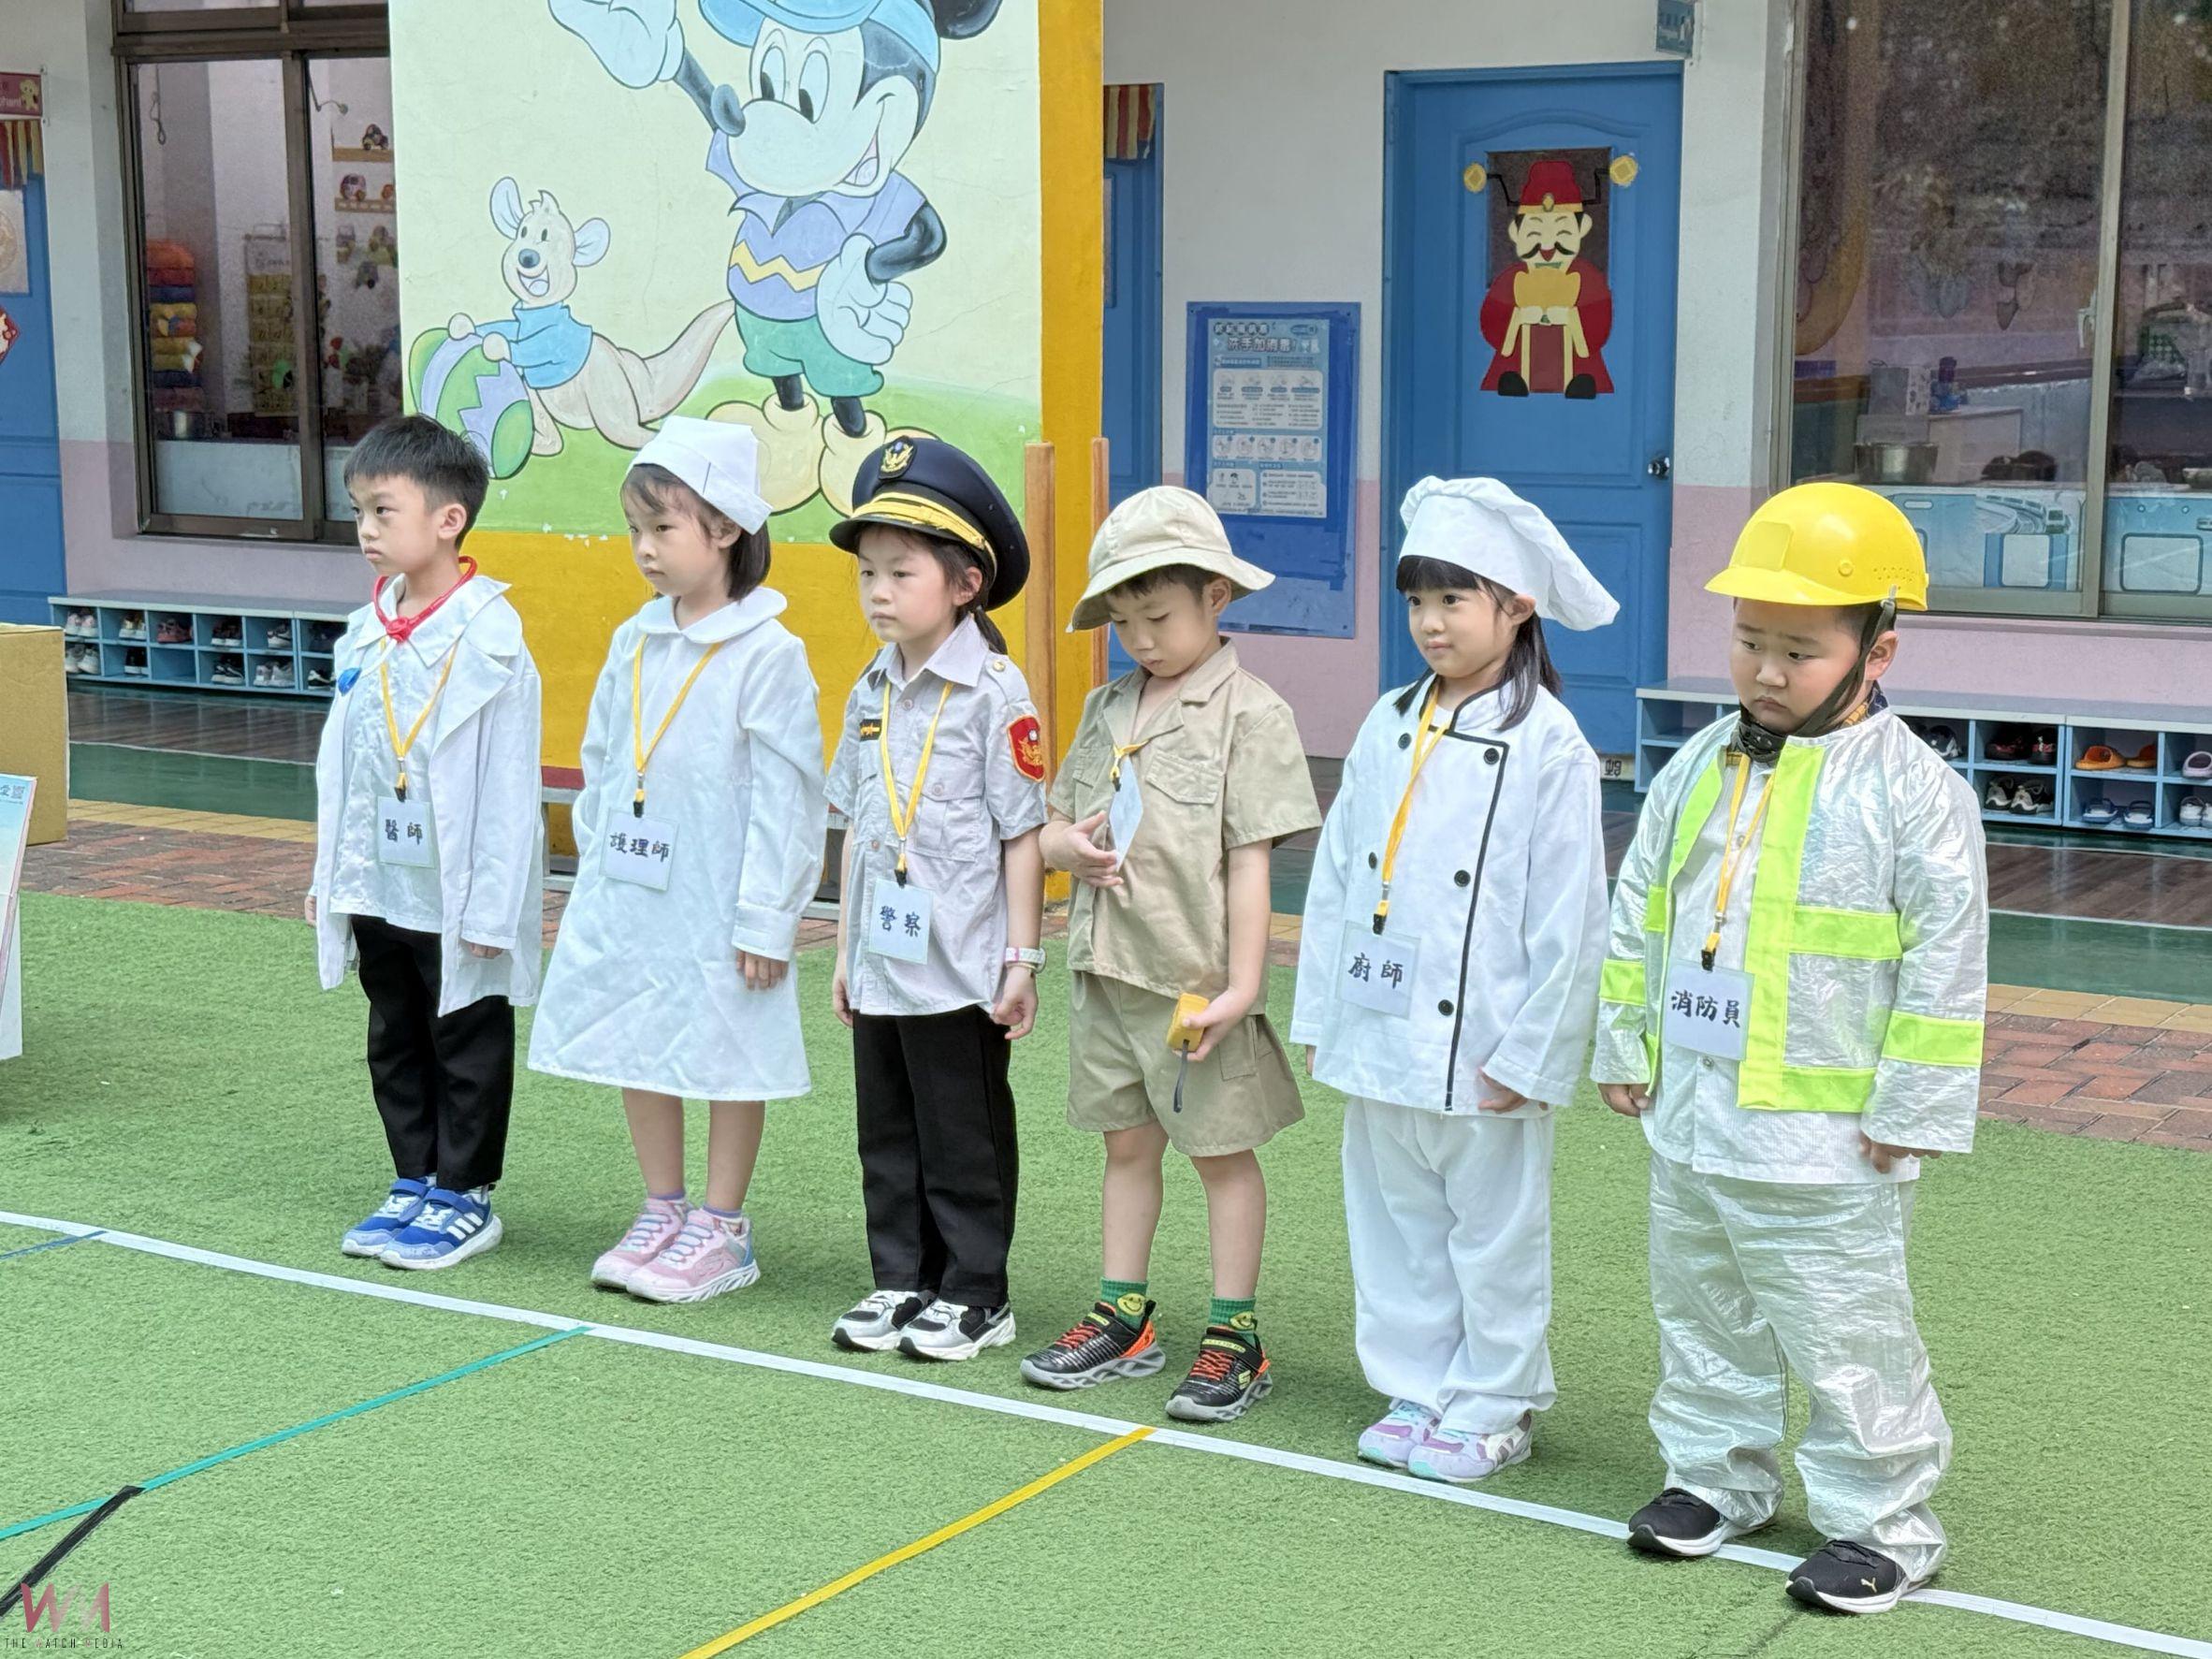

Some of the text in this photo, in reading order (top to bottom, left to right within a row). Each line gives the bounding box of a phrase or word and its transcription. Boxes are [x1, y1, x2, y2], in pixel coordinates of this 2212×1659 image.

[385, 819, 424, 846] 醫師
[610, 832, 670, 863] 護理師
[880, 905, 921, 938] 警察
[1348, 952, 1404, 990] 廚師
[1671, 989, 1740, 1028] 消防員
